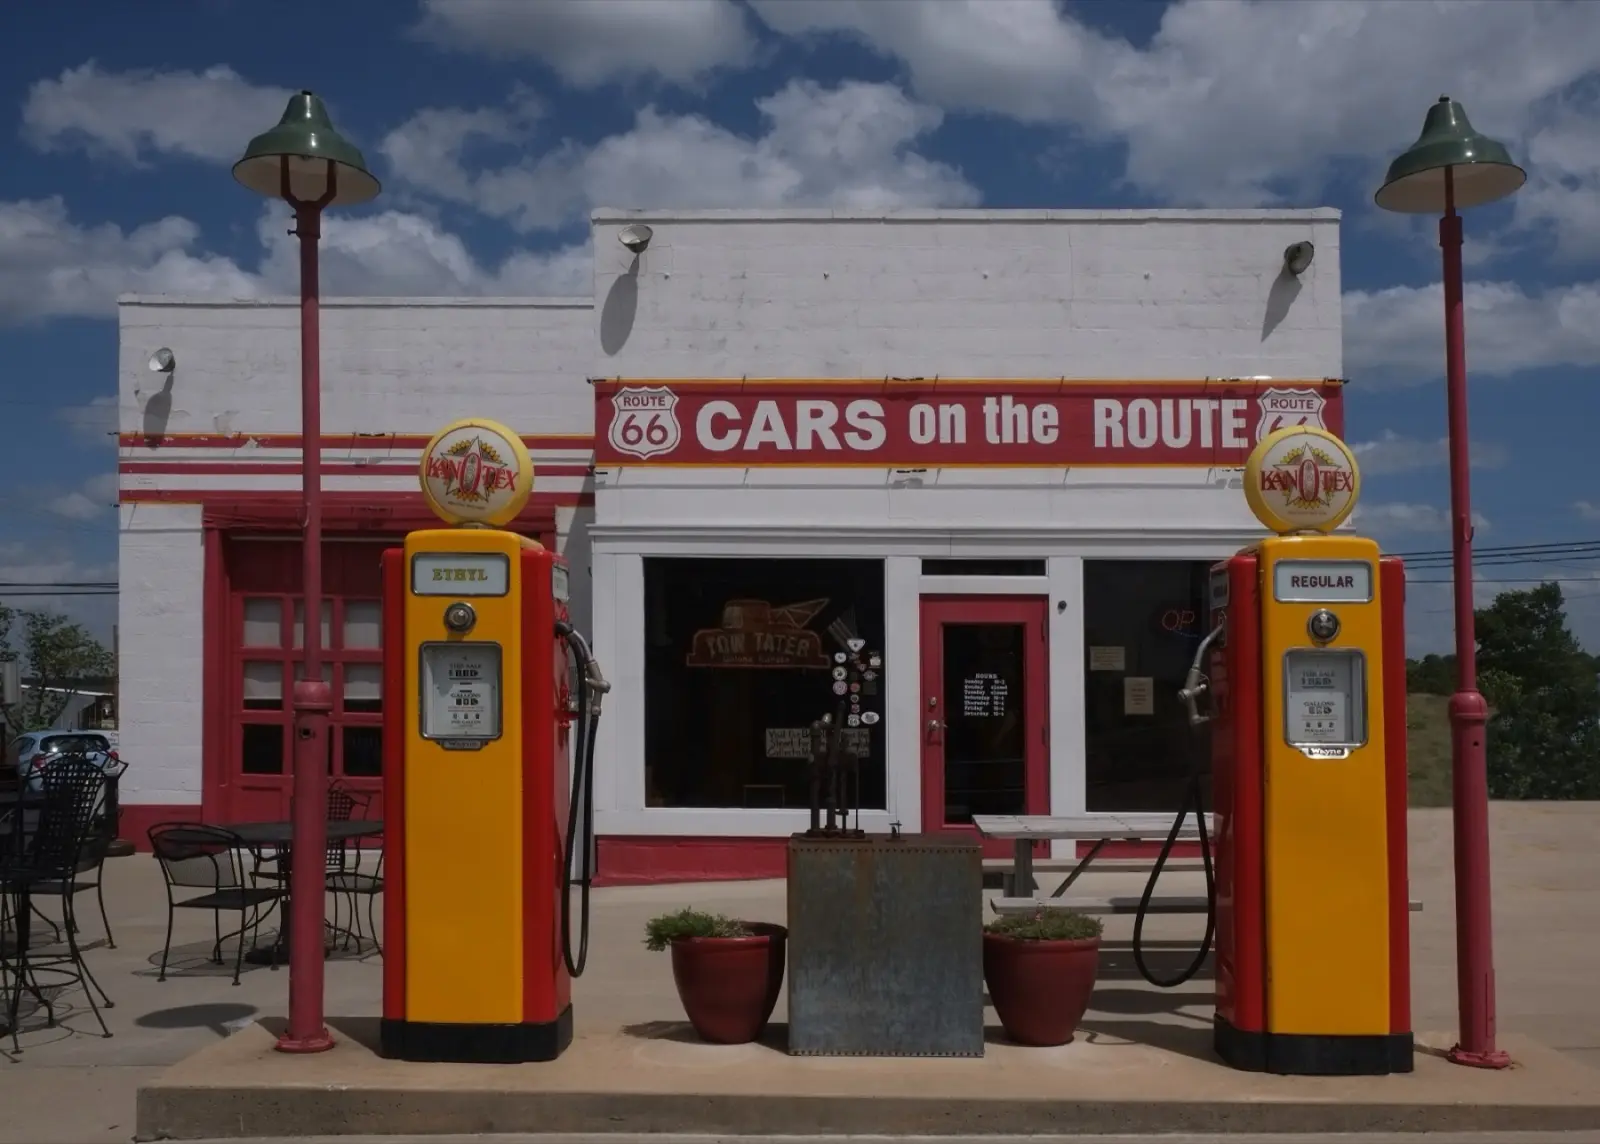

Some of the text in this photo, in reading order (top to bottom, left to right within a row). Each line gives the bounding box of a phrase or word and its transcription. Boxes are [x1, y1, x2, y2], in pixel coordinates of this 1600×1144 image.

[624, 396, 666, 407] ROUTE
[1270, 398, 1314, 409] ROUTE
[621, 413, 669, 446] 66
[695, 395, 1249, 452] CARS on the ROUTE
[432, 568, 489, 582] ETHYL
[1290, 575, 1355, 588] REGULAR
[753, 632, 810, 657] TATER
